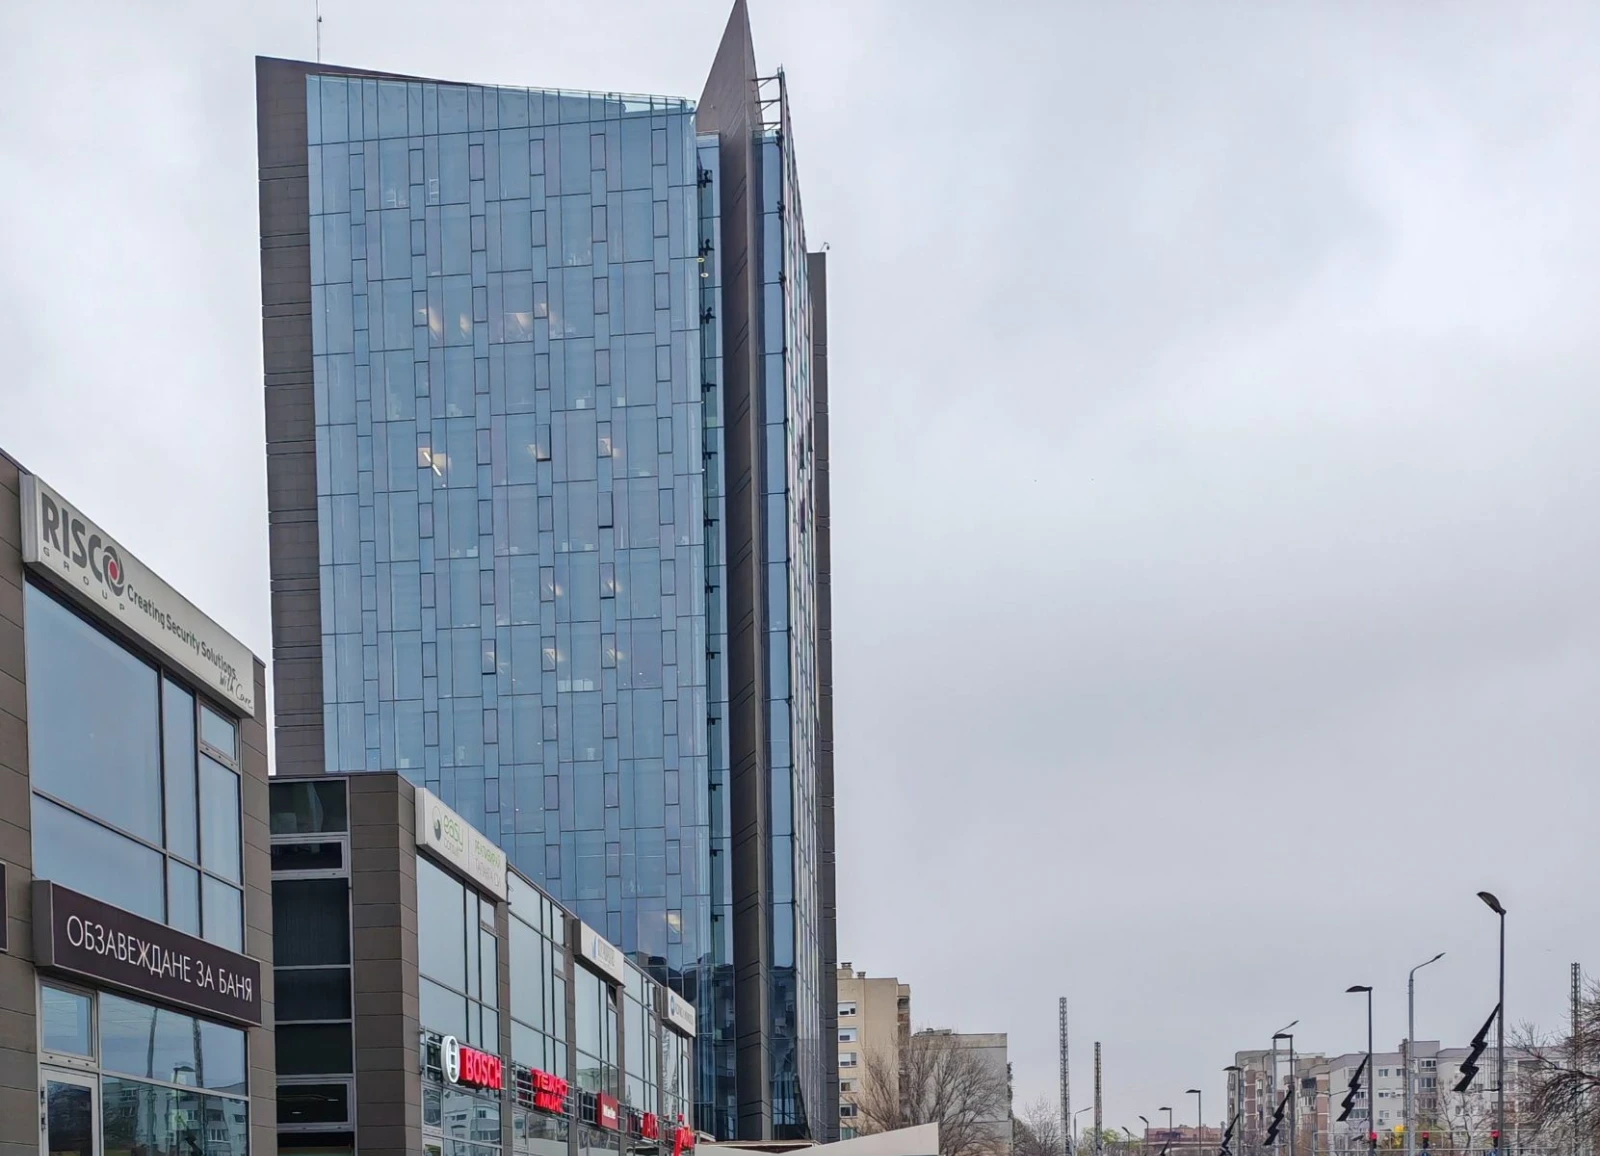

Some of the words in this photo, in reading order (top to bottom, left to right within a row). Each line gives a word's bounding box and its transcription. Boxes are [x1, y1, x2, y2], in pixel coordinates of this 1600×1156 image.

[41, 491, 124, 597] RISCO
[43, 546, 125, 611] GROUP
[127, 583, 165, 630] Creating
[166, 613, 201, 656] Security
[66, 915, 192, 983] ОБЗАВЕЖДАНЕ
[195, 960, 215, 990] ЗА
[218, 968, 253, 1002] БАНЯ
[464, 1047, 503, 1089] BOSCH
